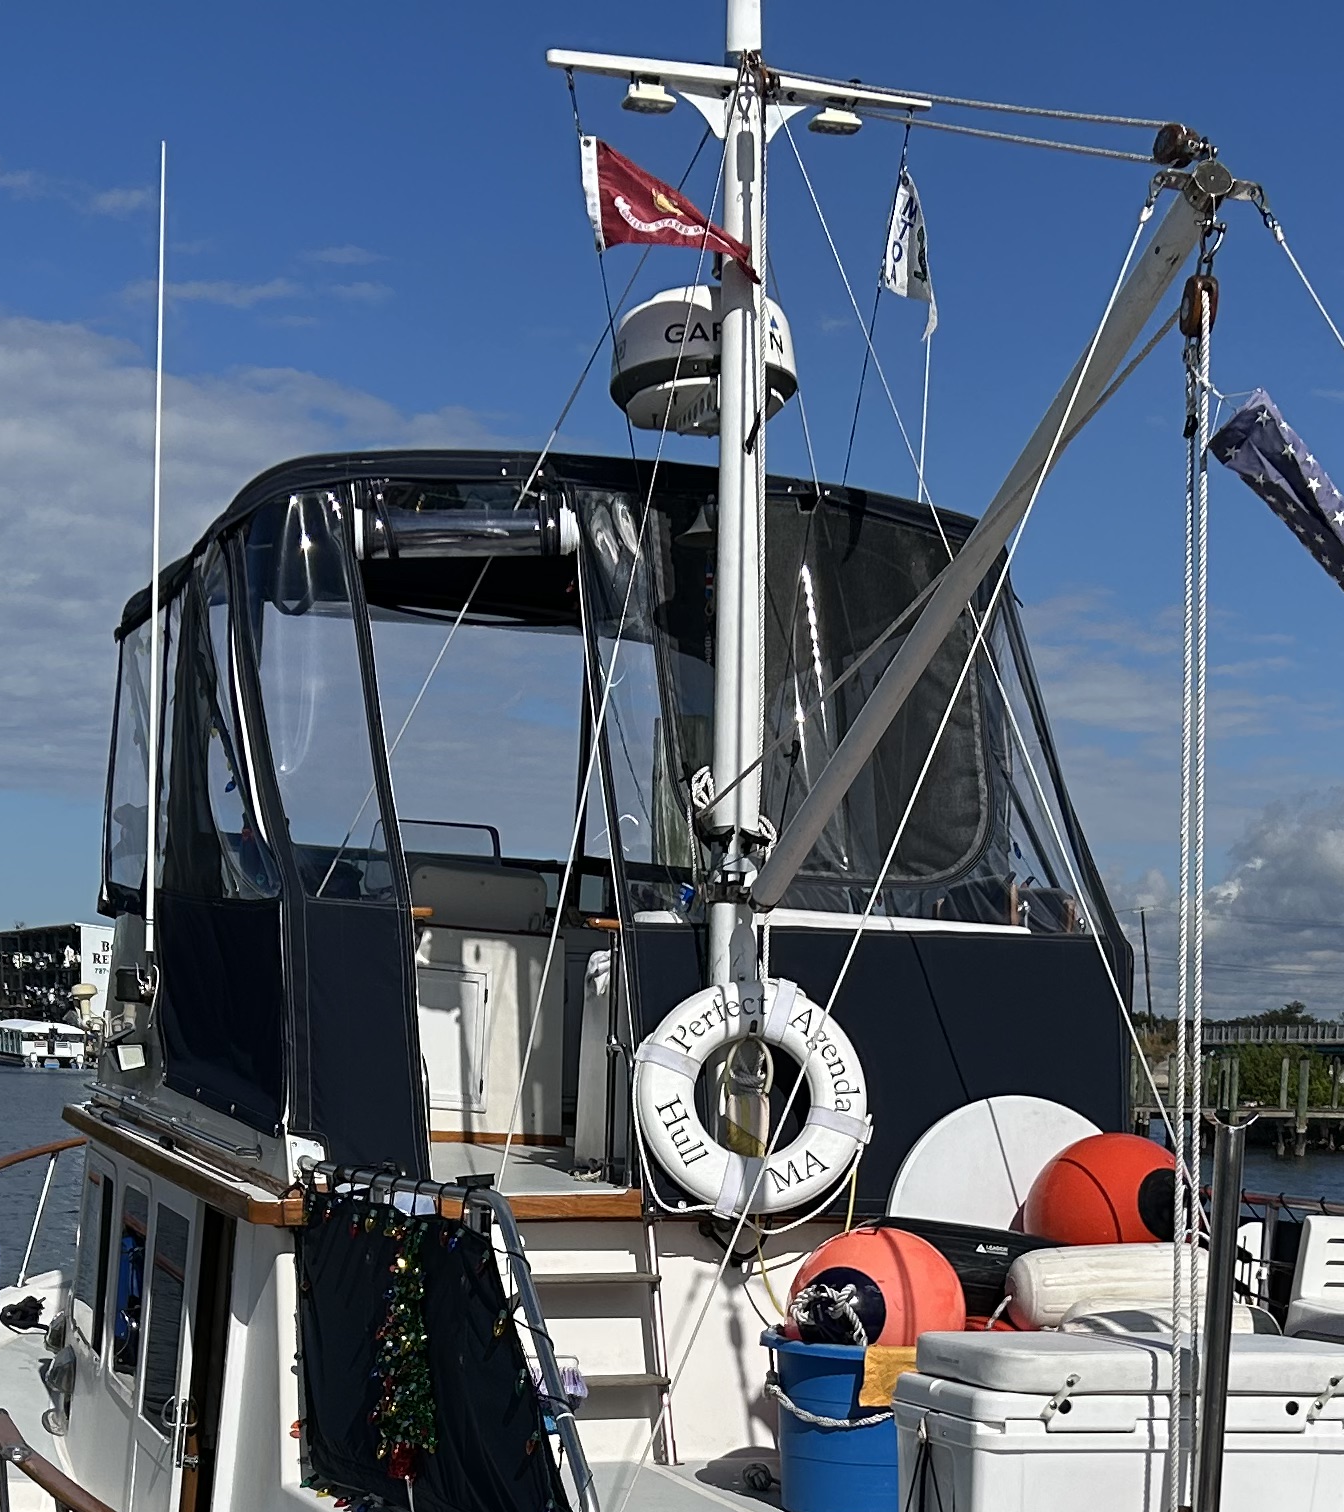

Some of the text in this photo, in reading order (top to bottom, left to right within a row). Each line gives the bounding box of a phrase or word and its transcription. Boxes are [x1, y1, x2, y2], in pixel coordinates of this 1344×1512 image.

[665, 994, 861, 1113] Perfect Agenda
[655, 1093, 830, 1194] Hull MA
